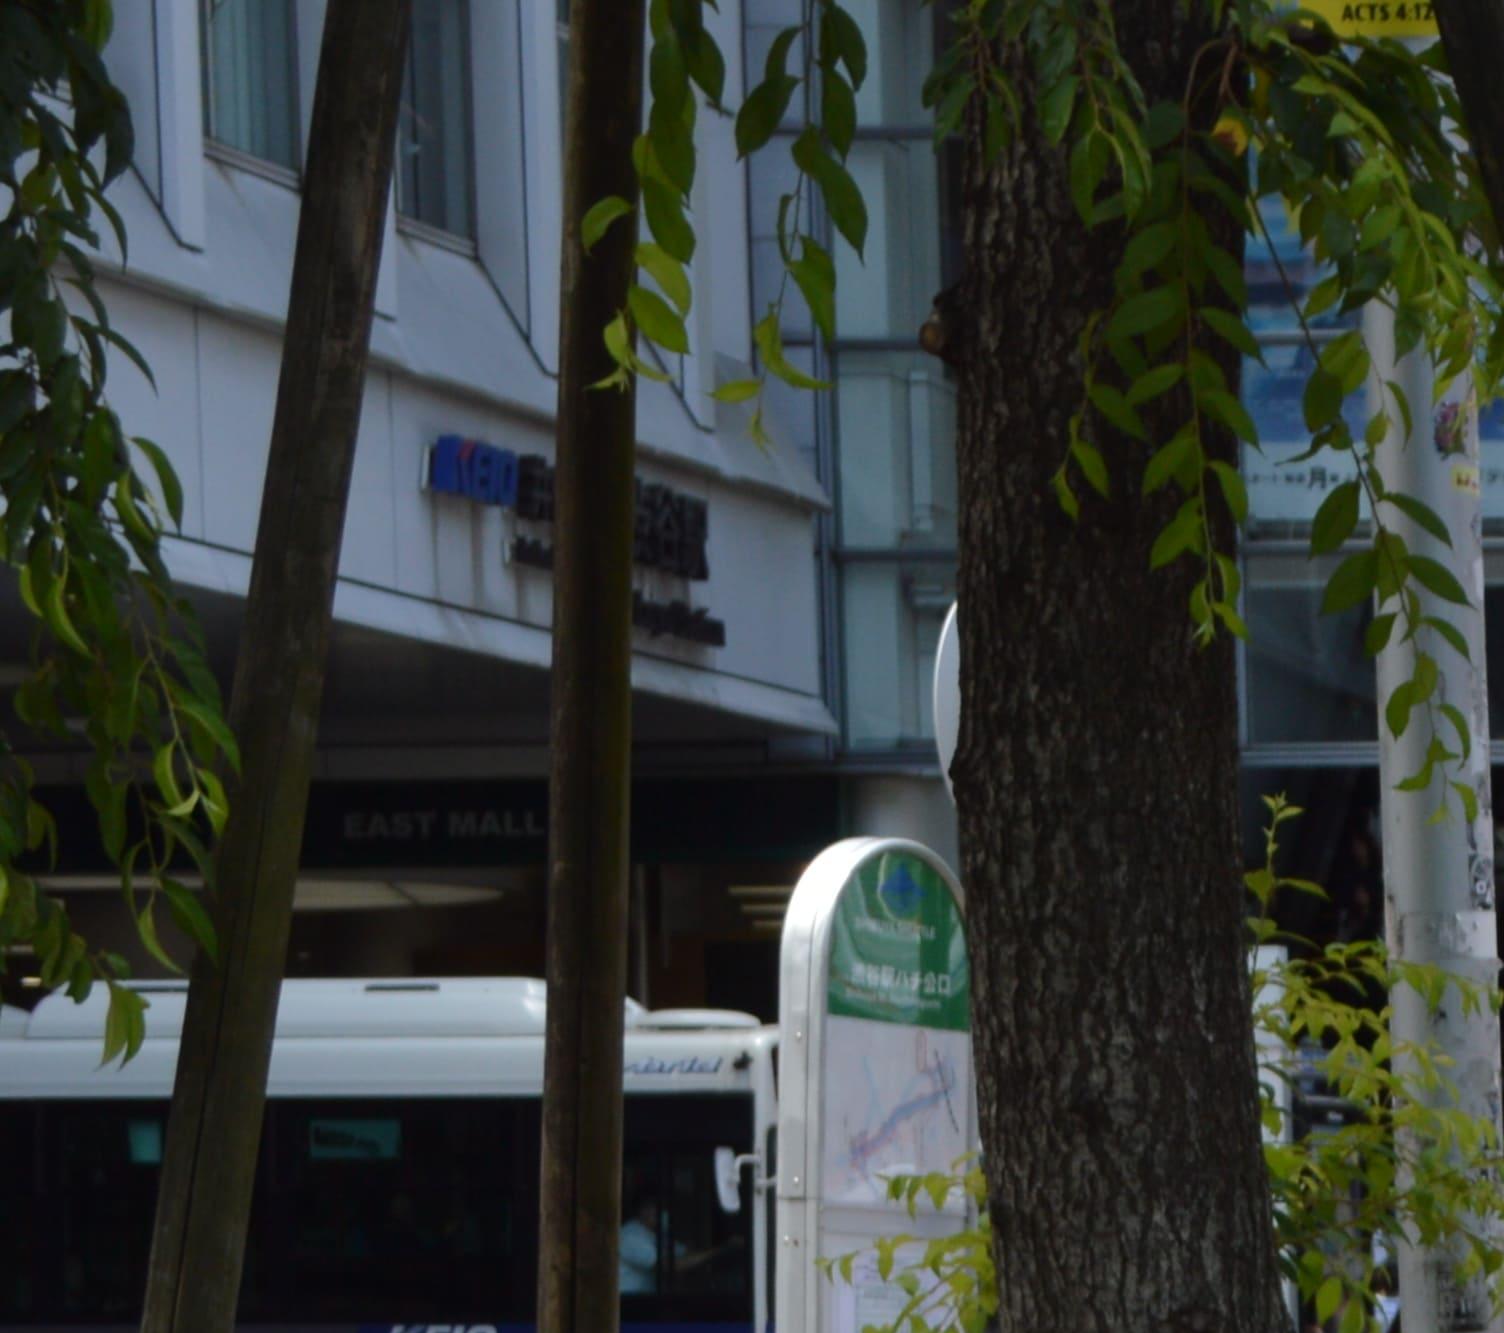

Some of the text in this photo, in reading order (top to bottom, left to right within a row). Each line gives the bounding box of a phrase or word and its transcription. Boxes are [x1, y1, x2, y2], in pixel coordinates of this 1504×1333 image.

[1342, 3, 1390, 21] ACTS
[344, 810, 547, 838] EAST MALL
